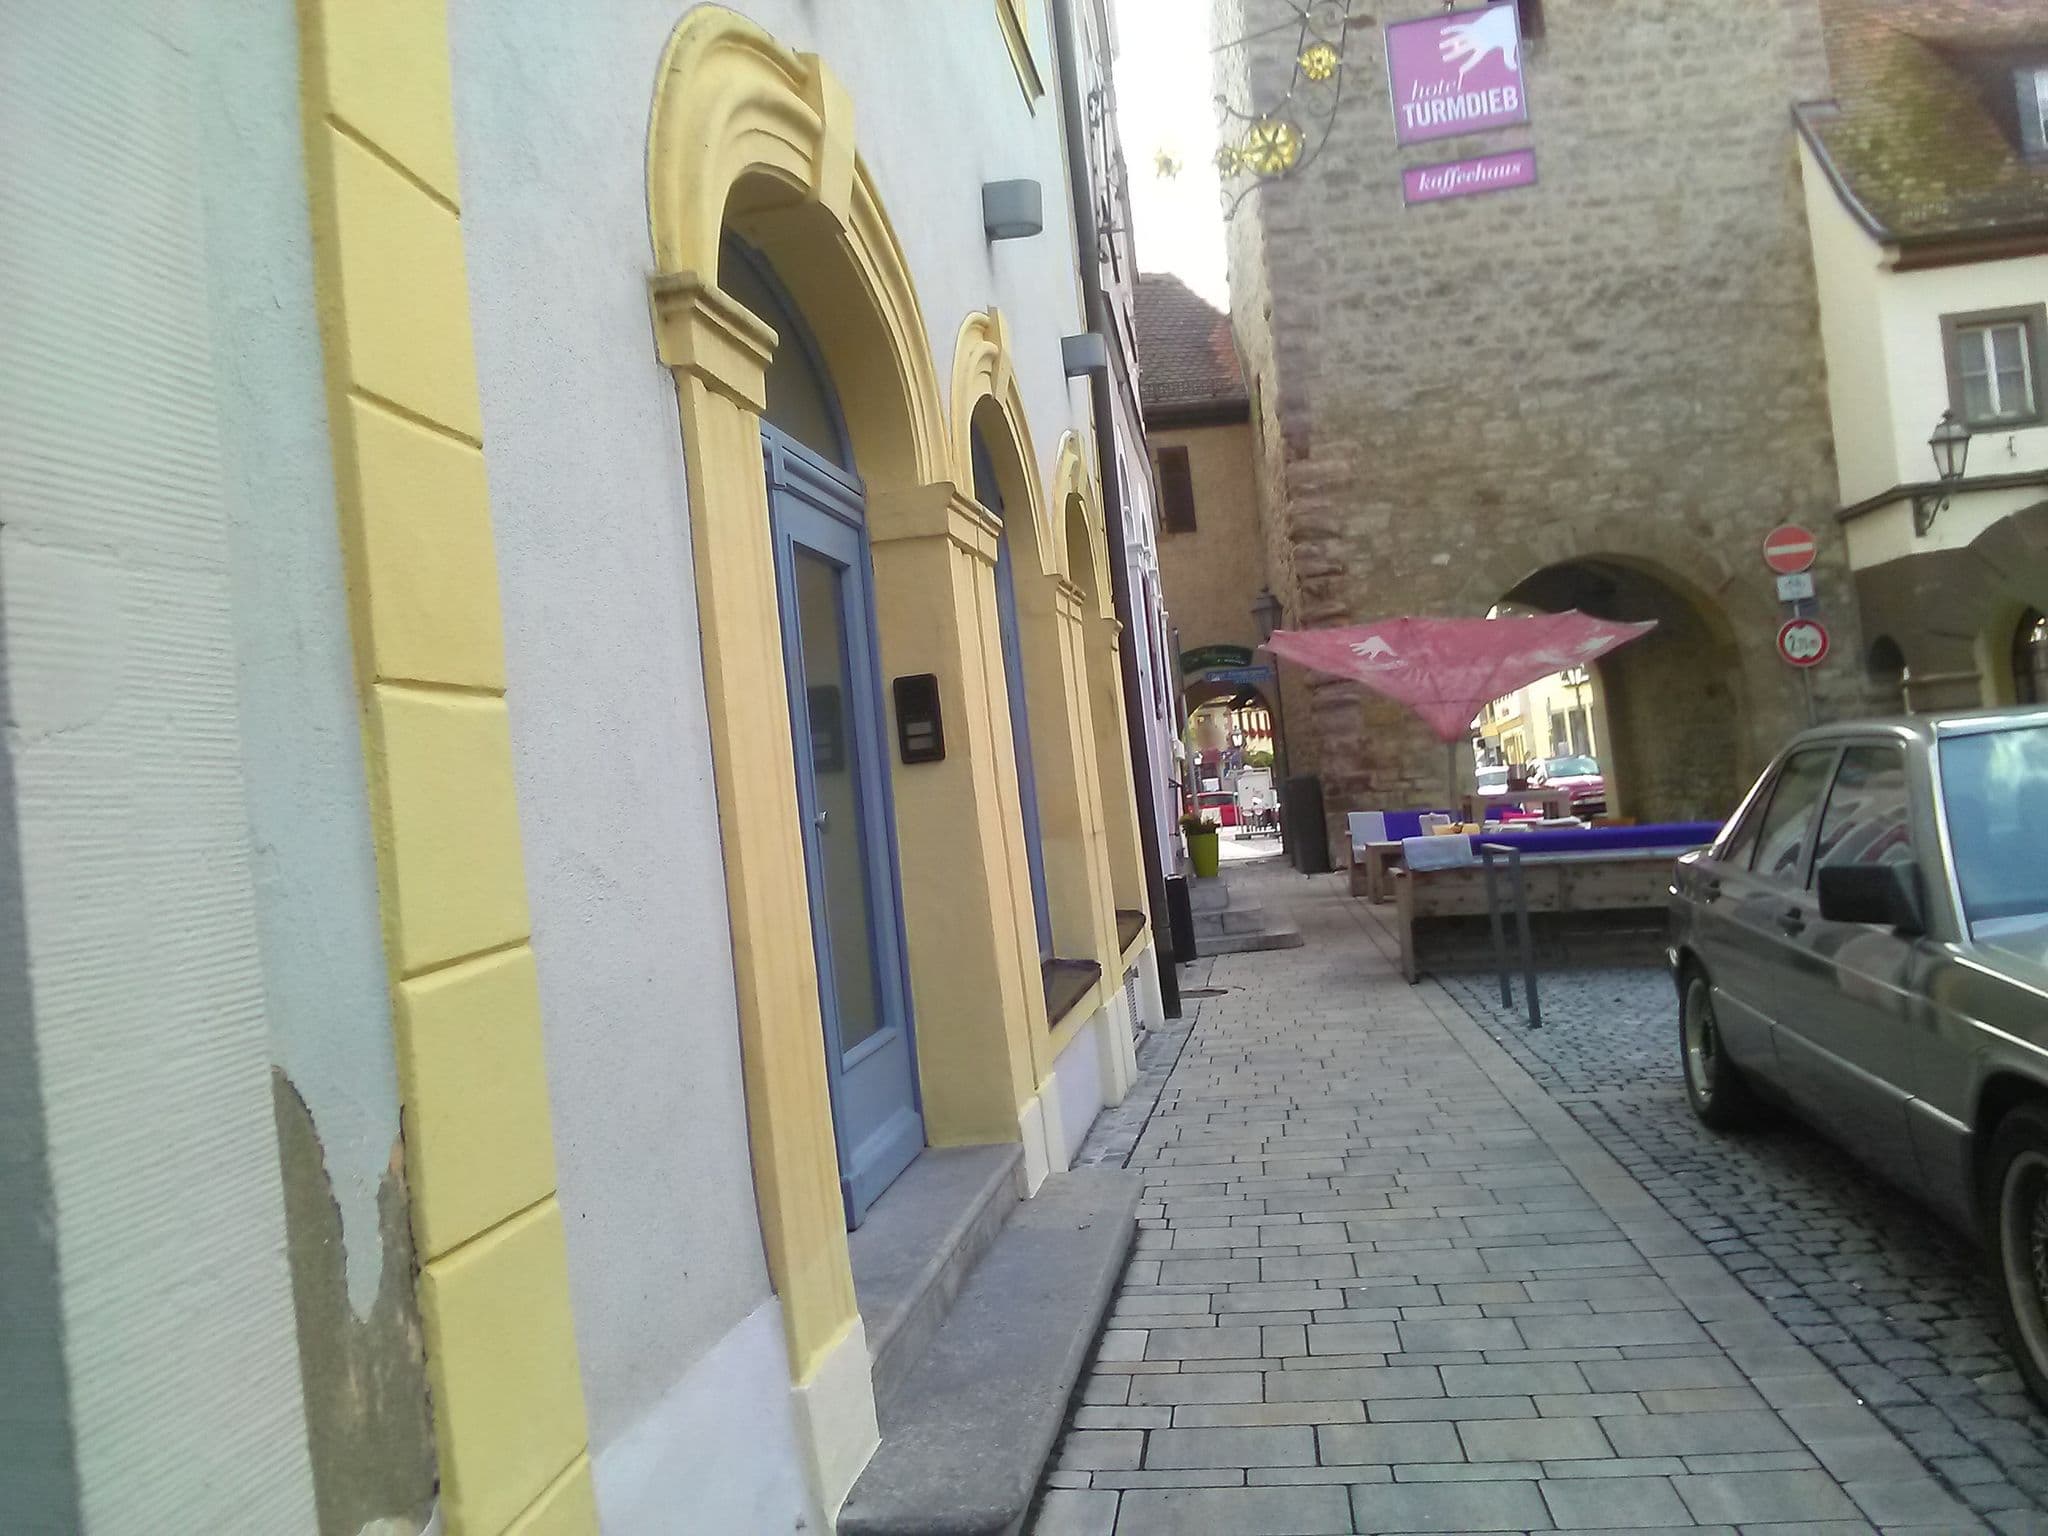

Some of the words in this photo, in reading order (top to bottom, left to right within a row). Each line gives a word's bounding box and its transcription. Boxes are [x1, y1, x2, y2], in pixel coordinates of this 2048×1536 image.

[1411, 74, 1464, 101] hotel
[1402, 86, 1519, 129] TURMDIEB
[1418, 162, 1522, 193] kaffeehaus
